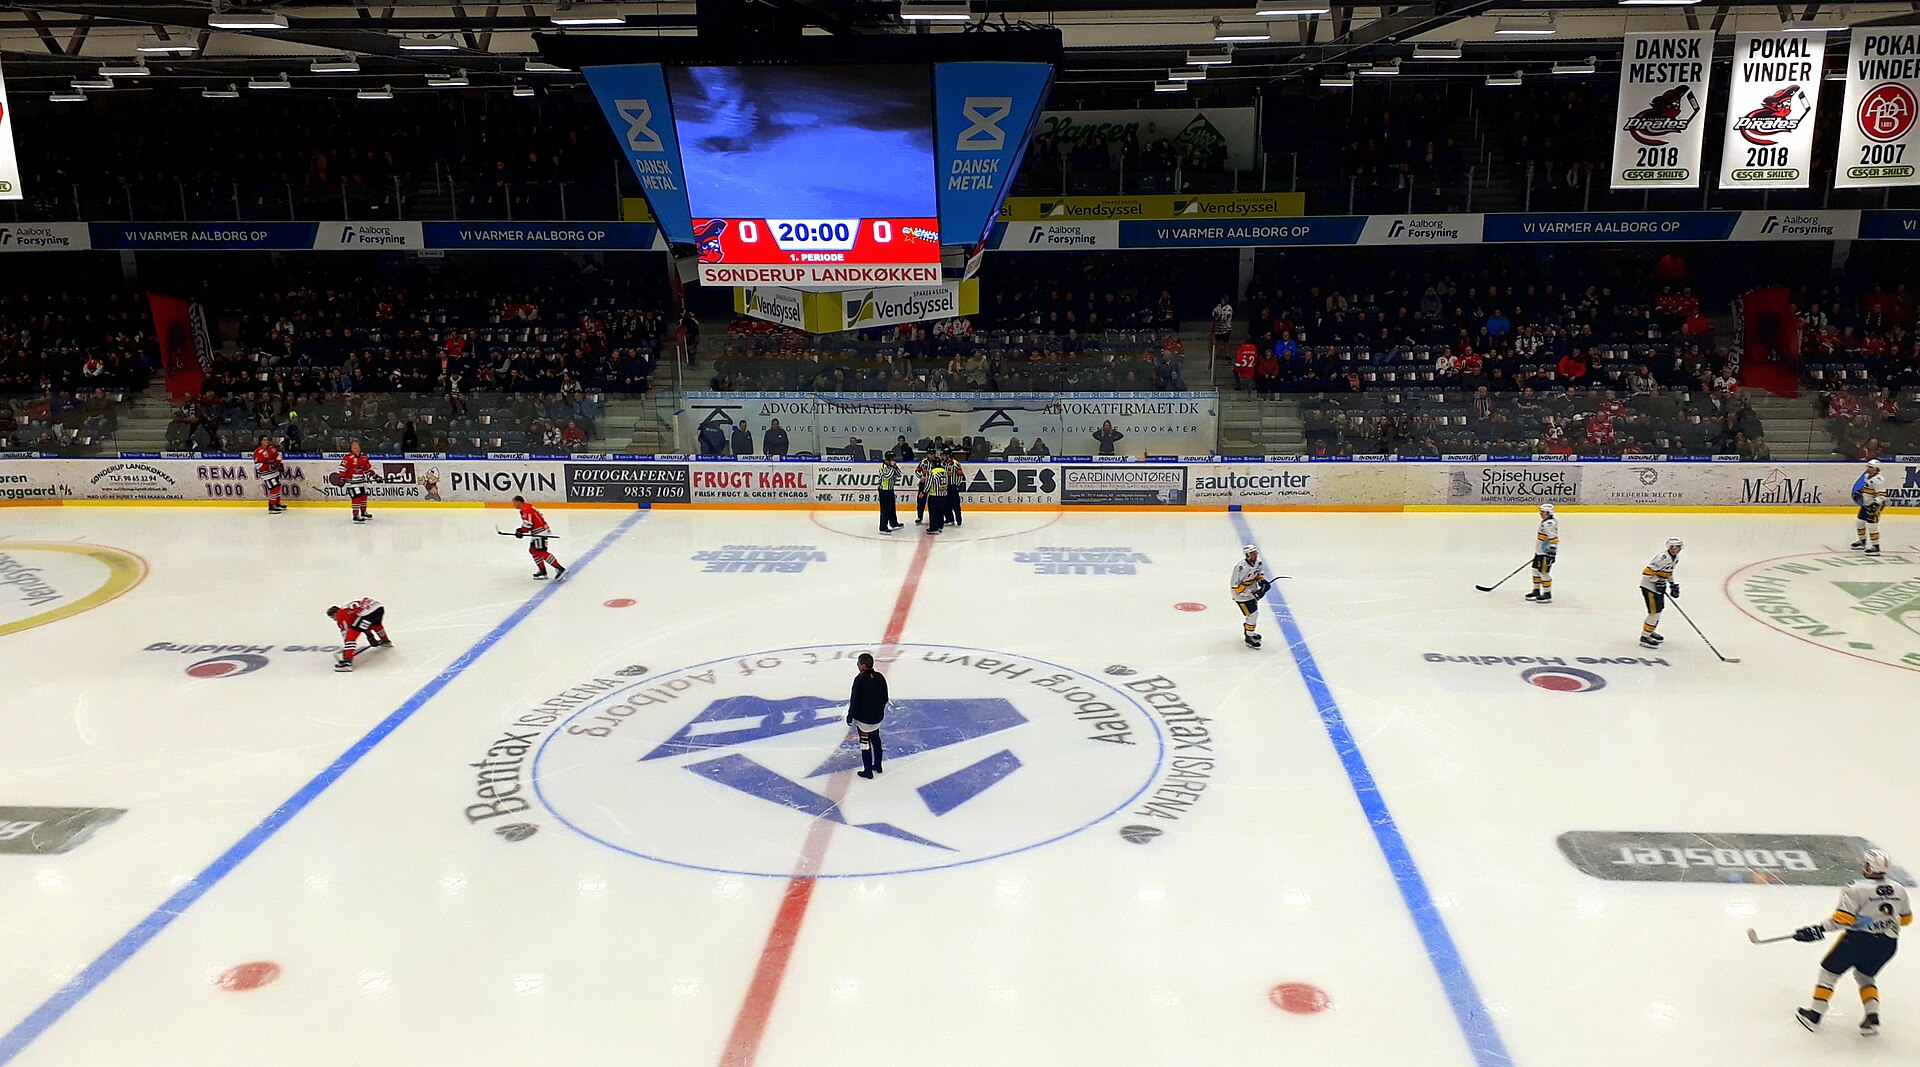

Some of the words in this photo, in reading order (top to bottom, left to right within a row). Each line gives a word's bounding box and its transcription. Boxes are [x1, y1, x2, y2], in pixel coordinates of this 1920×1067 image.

[1635, 38, 1701, 59] DANSK
[1749, 38, 1811, 58] POKAL
[1629, 62, 1702, 83] MESTER
[1742, 62, 1811, 82] VINDER
[1636, 147, 1679, 167] 2018
[1746, 147, 1788, 167] 2018
[1860, 144, 1906, 164] 2007
[637, 159, 673, 175] DANSK
[951, 159, 1000, 173] DANSK
[1852, 168, 1879, 177] ESSER
[1882, 167, 1909, 176] SKILTE
[1627, 171, 1655, 180] ESSER
[1657, 171, 1684, 179] SKILTE
[1737, 171, 1764, 180] ESSER
[1767, 171, 1794, 179] SKILTE
[642, 175, 678, 191] METAL
[948, 175, 994, 191] METAL
[1066, 203, 1143, 220] Vendsyssel
[1200, 200, 1278, 218] Vendsyssel
[1409, 219, 1443, 230] Aalborg
[1523, 222, 1535, 233] VI
[1538, 222, 1591, 233] VARMER
[1594, 222, 1657, 233] AALBORG
[1660, 221, 1680, 232] OP
[1783, 215, 1819, 226] Aalborg
[1903, 220, 1916, 231] VI
[16, 227, 52, 238] Aalborg
[125, 231, 137, 241] VI
[139, 231, 187, 241] VARMER
[191, 231, 248, 241] AALBORG
[250, 230, 267, 241] OP
[359, 226, 391, 237] Aalborg
[459, 230, 471, 241] VI
[474, 230, 522, 241] VARMER
[526, 230, 585, 241] AALBORG
[587, 230, 605, 241] OP
[739, 221, 758, 242] 0
[779, 223, 849, 241] 20:00
[873, 221, 892, 242] 0
[1048, 225, 1081, 235] Aalborg
[1157, 228, 1169, 239] VI
[1172, 228, 1224, 239] VARMER
[1227, 227, 1288, 239] AALBORG
[1291, 226, 1310, 238] OP
[1408, 227, 1458, 239] Forsyning
[1782, 224, 1833, 236] Forsyning
[17, 235, 70, 246] Forsyning
[359, 234, 406, 246] Forsyning
[1048, 232, 1096, 245] Forsyning
[705, 268, 805, 282] SØNDERUP
[812, 268, 937, 281] LANDKØKKEN
[913, 288, 949, 298] SPAREKASSEN
[756, 295, 801, 322] Vendsyssel
[875, 292, 954, 319] Vendsyssel
[761, 402, 914, 415] ADVOKATFIRMAET.DK
[1042, 402, 1199, 415] ADVOKATFIRMAET.DK
[843, 425, 913, 433] ADVOKATER
[1126, 425, 1198, 433] ADVOKATER
[90, 464, 124, 485] SØNDERUP
[125, 463, 176, 485] LANDKØKKEN
[197, 466, 248, 480] REMA
[254, 466, 306, 480] RMA
[573, 470, 685, 481] FOTOGRAFERNE
[1069, 472, 1180, 482] GARDINMONTØREN
[1205, 471, 1311, 488] autocenter
[1482, 468, 1565, 484] Spisehuset
[451, 473, 556, 491] PINGVIN
[693, 472, 752, 489] FRUGT
[759, 472, 807, 489] KARL
[817, 474, 831, 486] K.
[836, 474, 914, 487] KNUDEN
[205, 484, 244, 497] 1000
[262, 484, 301, 497] 100
[324, 487, 405, 496] STILLADLEJNING
[406, 487, 418, 496] A/S
[570, 486, 604, 497] NIBE
[625, 486, 652, 497] 9835
[656, 486, 684, 497] 1050
[1481, 483, 1515, 495] Kniv
[1517, 483, 1531, 495] &
[1532, 483, 1577, 496] Gaffel
[1740, 478, 1822, 504] MailMak
[840, 493, 856, 502] Tlf.
[859, 493, 870, 502] 98
[691, 550, 828, 563] WATER
[1012, 552, 1154, 565] WATER
[700, 561, 809, 573] BLUE
[1034, 563, 1138, 576] BLUE
[143, 641, 274, 654] Holding
[283, 645, 342, 653] ove
[740, 656, 783, 676] of
[923, 650, 1035, 680] Havn
[1423, 653, 1567, 666] Holding
[1575, 656, 1671, 667] Hove
[567, 669, 717, 738] Aalborg
[1031, 675, 1136, 746] Aalborg
[1123, 675, 1214, 752] Bentax
[465, 731, 541, 825] Bentax
[1610, 847, 1820, 872] Booster
